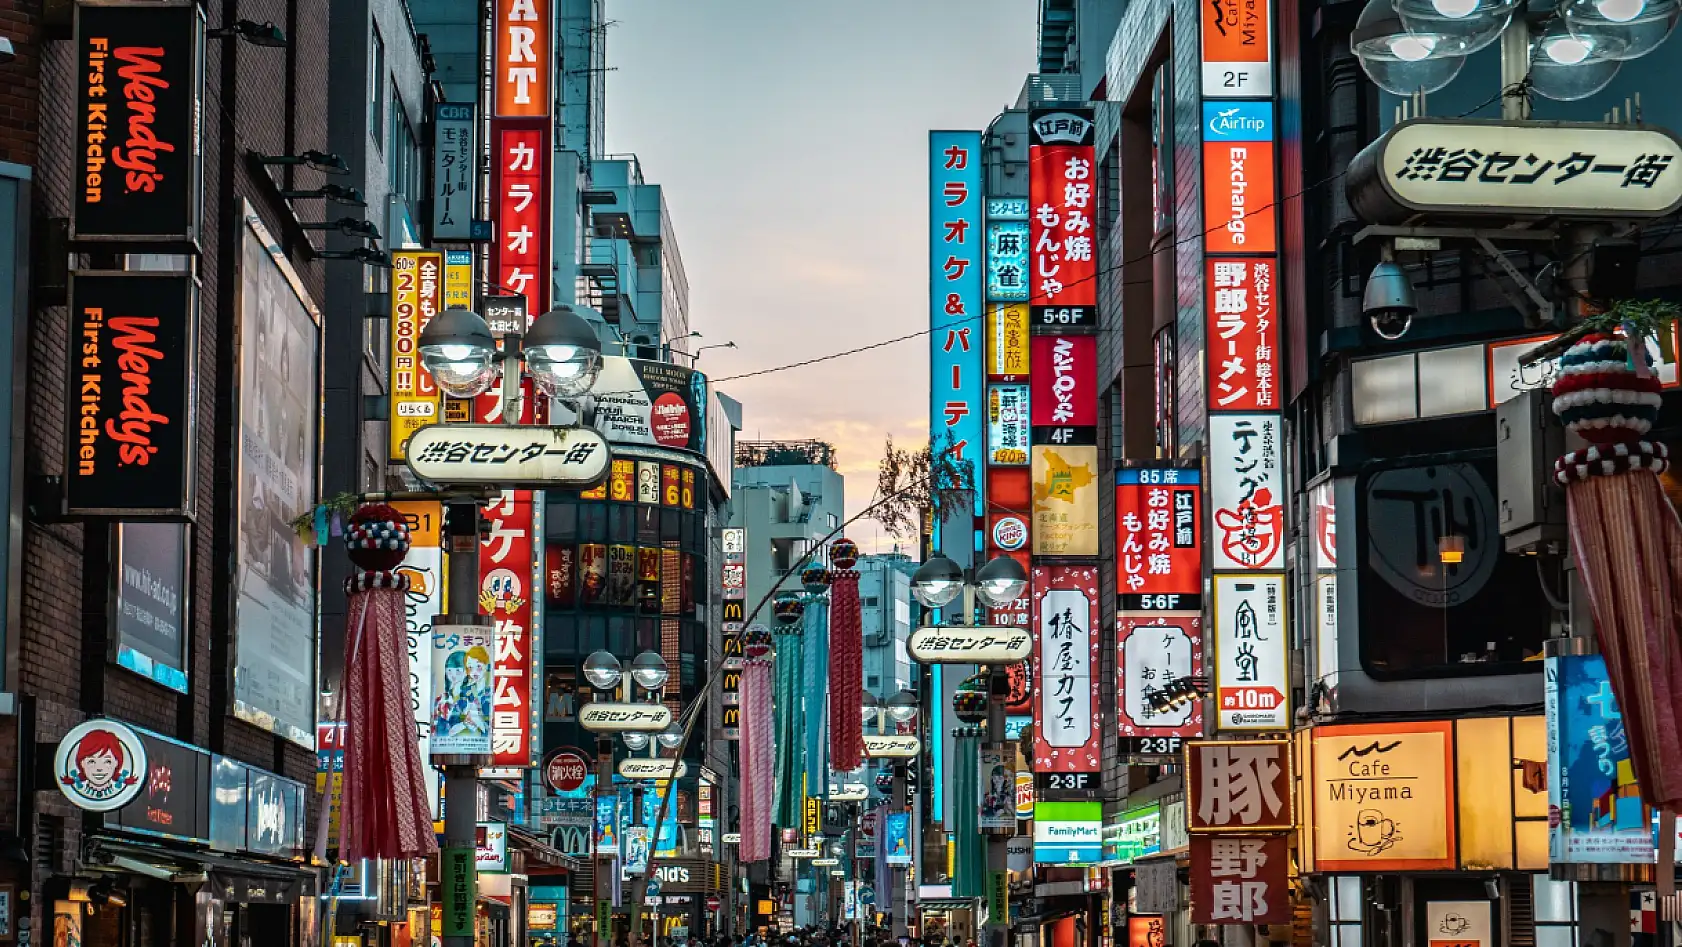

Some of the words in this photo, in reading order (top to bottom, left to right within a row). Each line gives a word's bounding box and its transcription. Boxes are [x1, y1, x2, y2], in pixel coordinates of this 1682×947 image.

[87, 37, 108, 98] First
[1223, 71, 1248, 87] 2F
[111, 46, 175, 194] Wendy's
[440, 107, 470, 118] CBR
[1039, 119, 1083, 136] 江戸前
[1220, 116, 1264, 132] AirTrip
[85, 102, 108, 203] Kitchen
[441, 127, 455, 227] モニタールーム
[1395, 147, 1675, 189] 渋谷センター街
[1064, 156, 1092, 262] お好み焼
[1228, 147, 1247, 245] Exchange
[997, 233, 1020, 287] 麻雀
[1035, 203, 1063, 299] もんじゃ
[81, 307, 103, 368] First
[1213, 261, 1248, 407] 野郎ラーメン
[104, 315, 170, 468] Wendy's
[78, 373, 101, 477] Kitchen
[1052, 428, 1074, 444] 4F
[416, 441, 599, 466] 渋谷センター街
[999, 530, 1023, 542] KING
[1147, 488, 1171, 575] お好み焼
[1175, 491, 1193, 545] 江戸前
[1121, 511, 1146, 592] もんじゃ
[917, 636, 1027, 651] 渋谷センター街
[583, 709, 667, 723] 渋谷センター街
[552, 765, 584, 781] 消火栓
[1197, 746, 1284, 826] 豚
[1329, 783, 1413, 804] Miyama
[1348, 760, 1390, 777] Cafe
[1048, 825, 1098, 836] FamilyMart
[1210, 838, 1269, 922] 野郎
